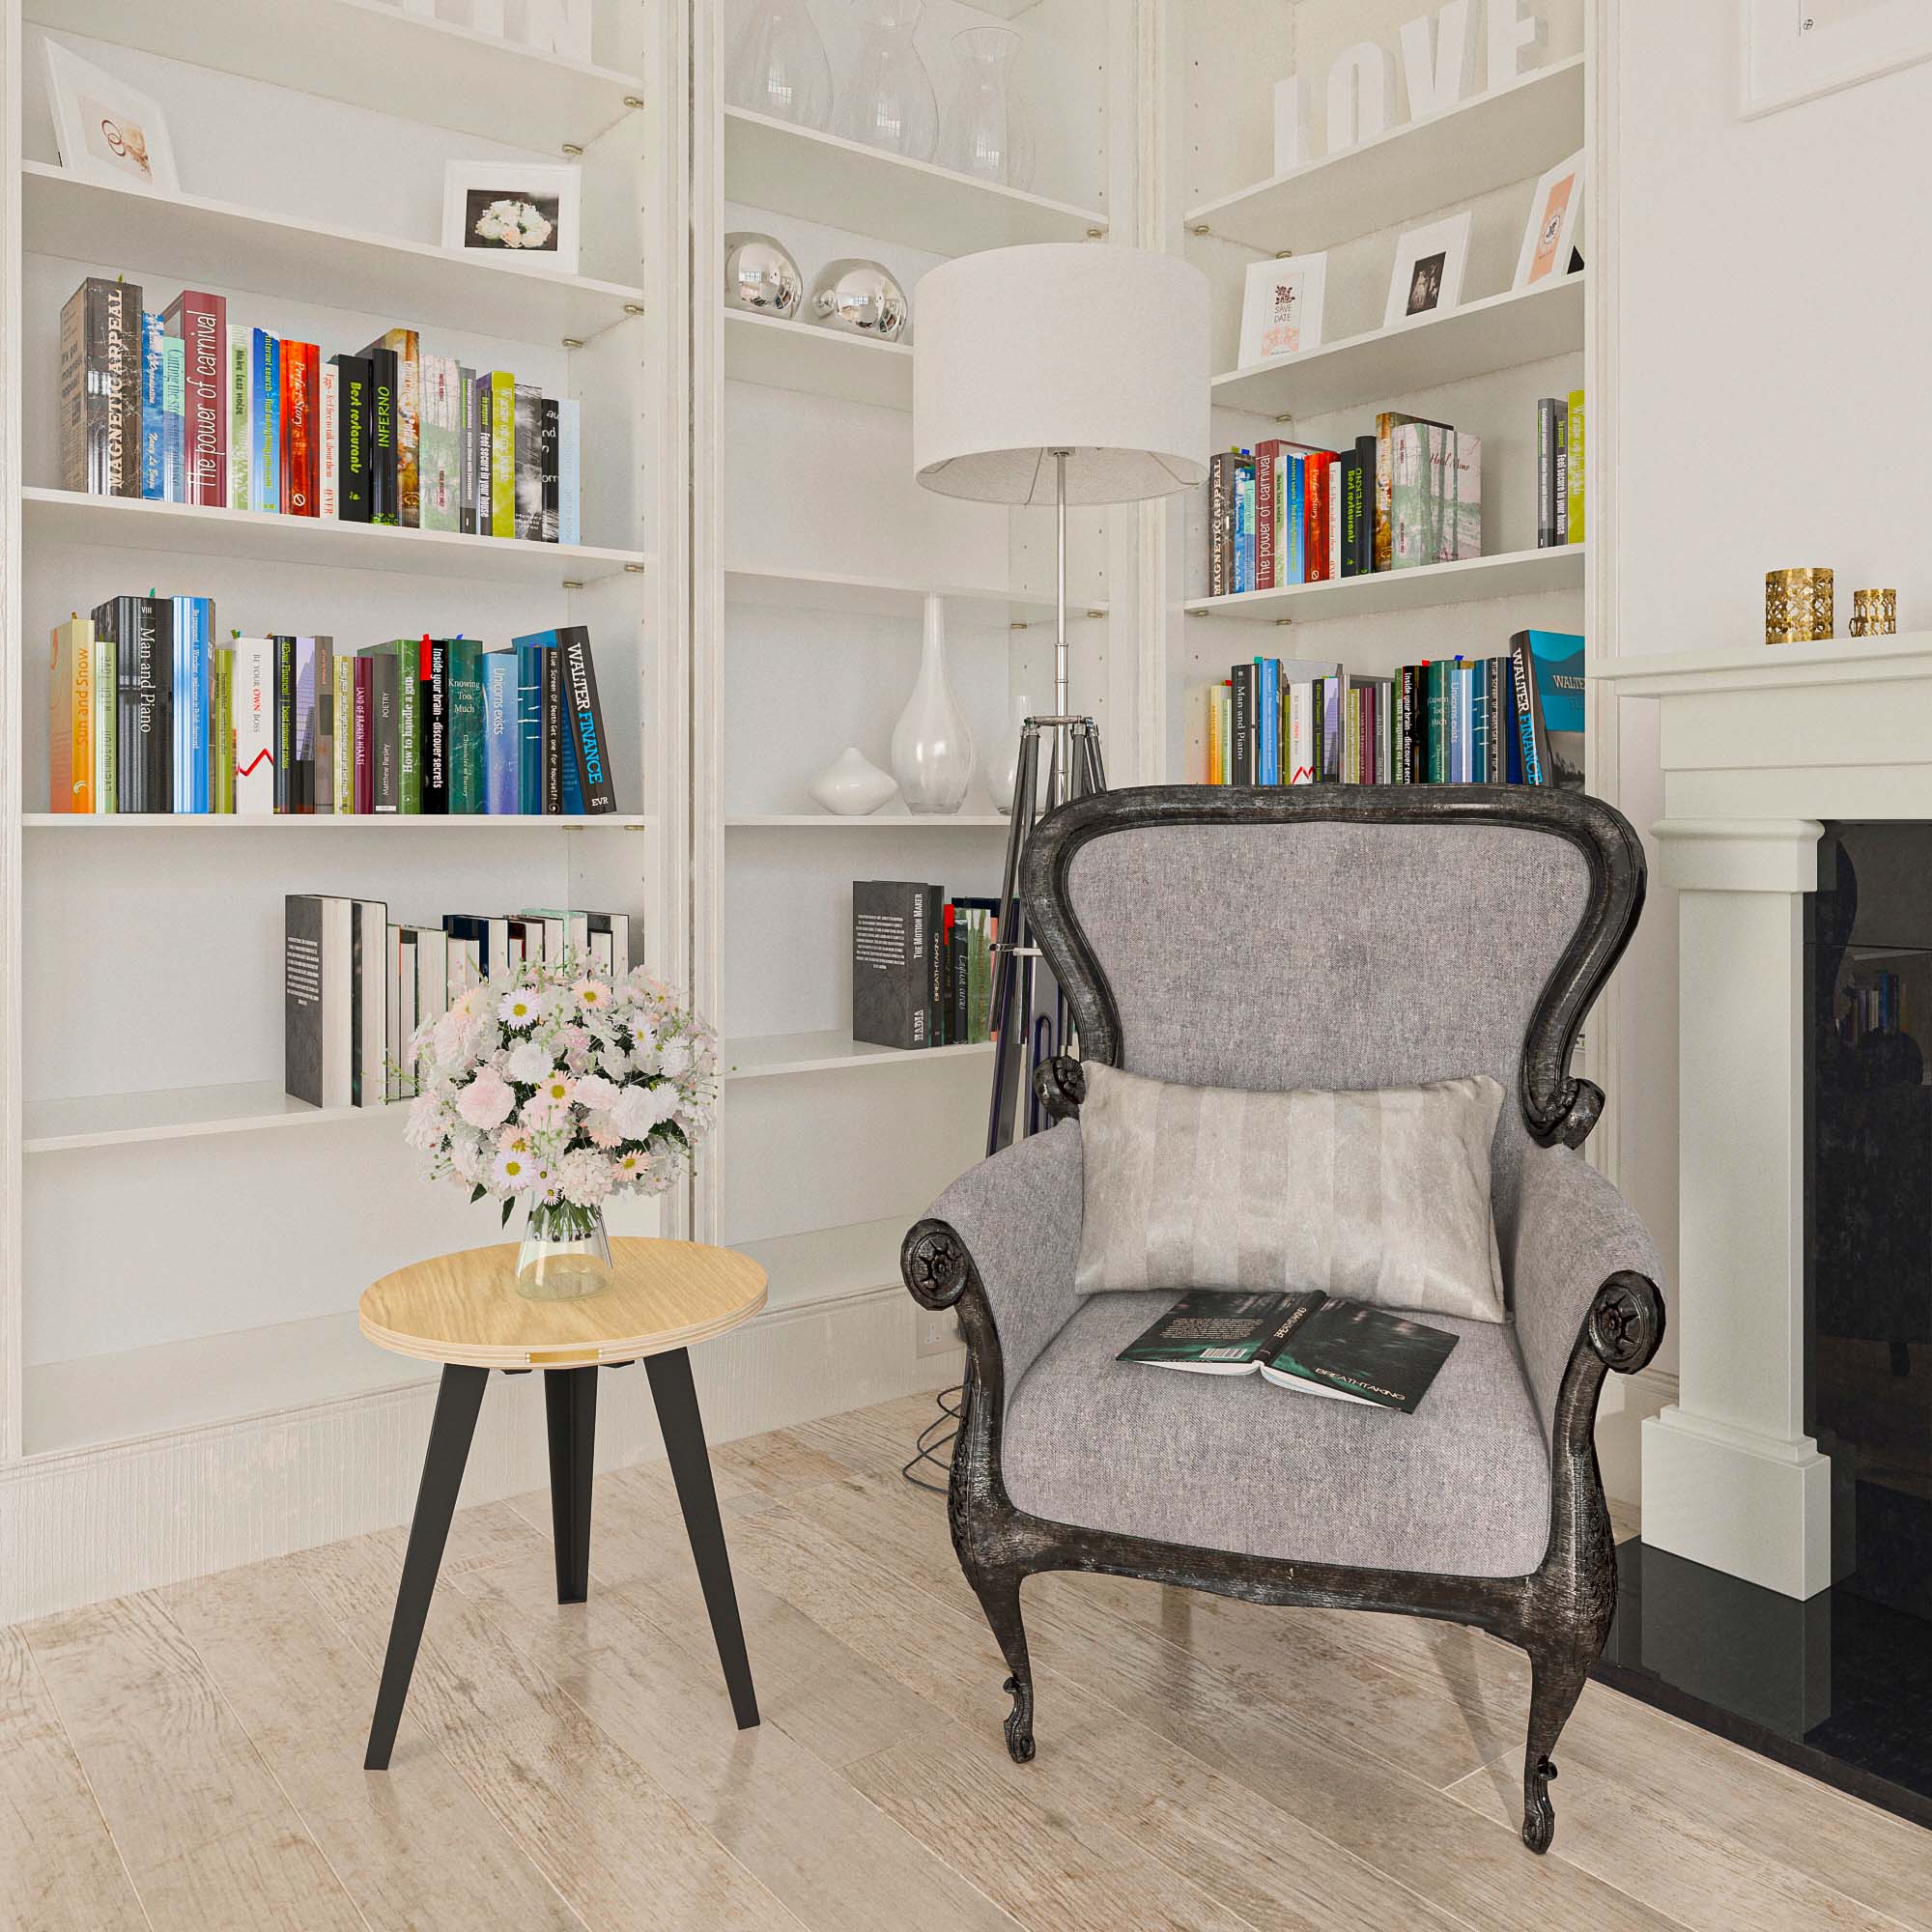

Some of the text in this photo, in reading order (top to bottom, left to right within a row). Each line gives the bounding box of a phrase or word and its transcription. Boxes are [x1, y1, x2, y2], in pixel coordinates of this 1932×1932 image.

[1274, 314, 1292, 323] DATE
[1275, 304, 1292, 313] SAVE
[236, 350, 245, 370] Make
[264, 335, 273, 366] Internet
[264, 367, 273, 391] search
[186, 310, 225, 487] The power of carnival
[236, 392, 245, 416] noise
[292, 361, 305, 426] Perfect Story
[350, 382, 362, 473] Best restaurants
[378, 386, 389, 448] INFERNO
[108, 378, 124, 488] MAGNETIC
[480, 433, 491, 446] Feel
[480, 447, 491, 471] secure
[1557, 454, 1566, 468] Feel
[480, 480, 491, 496] your
[1557, 469, 1566, 491] secure
[480, 497, 491, 518] house
[1557, 499, 1566, 514] your
[1256, 455, 1275, 583] The power of carnival
[1557, 515, 1566, 535] house
[140, 628, 156, 733] Man and Piano
[448, 678, 480, 691] Knowing
[567, 642, 591, 711] WALTER
[76, 648, 88, 746] Sun and Snow
[253, 689, 262, 712] OWN
[355, 687, 365, 704] LAND
[458, 691, 471, 700] Too
[493, 668, 506, 735] Unicorns exists
[402, 704, 413, 737] handle
[431, 648, 443, 788] Inside your brain discover secrets
[454, 704, 475, 713] Much
[1513, 646, 1544, 785] WALTER FINANCE
[253, 714, 262, 733] BOSS
[1237, 686, 1246, 760] Man and Piano
[355, 741, 365, 765] HEARTS
[382, 743, 390, 766] Parsley
[402, 739, 413, 748] to
[578, 710, 604, 784] FINANCE
[402, 751, 413, 774] How
[591, 796, 609, 807] EVR
[913, 894, 923, 960] THE MOTION MAKER
[1315, 1367, 1406, 1401] BREATHTAKING
